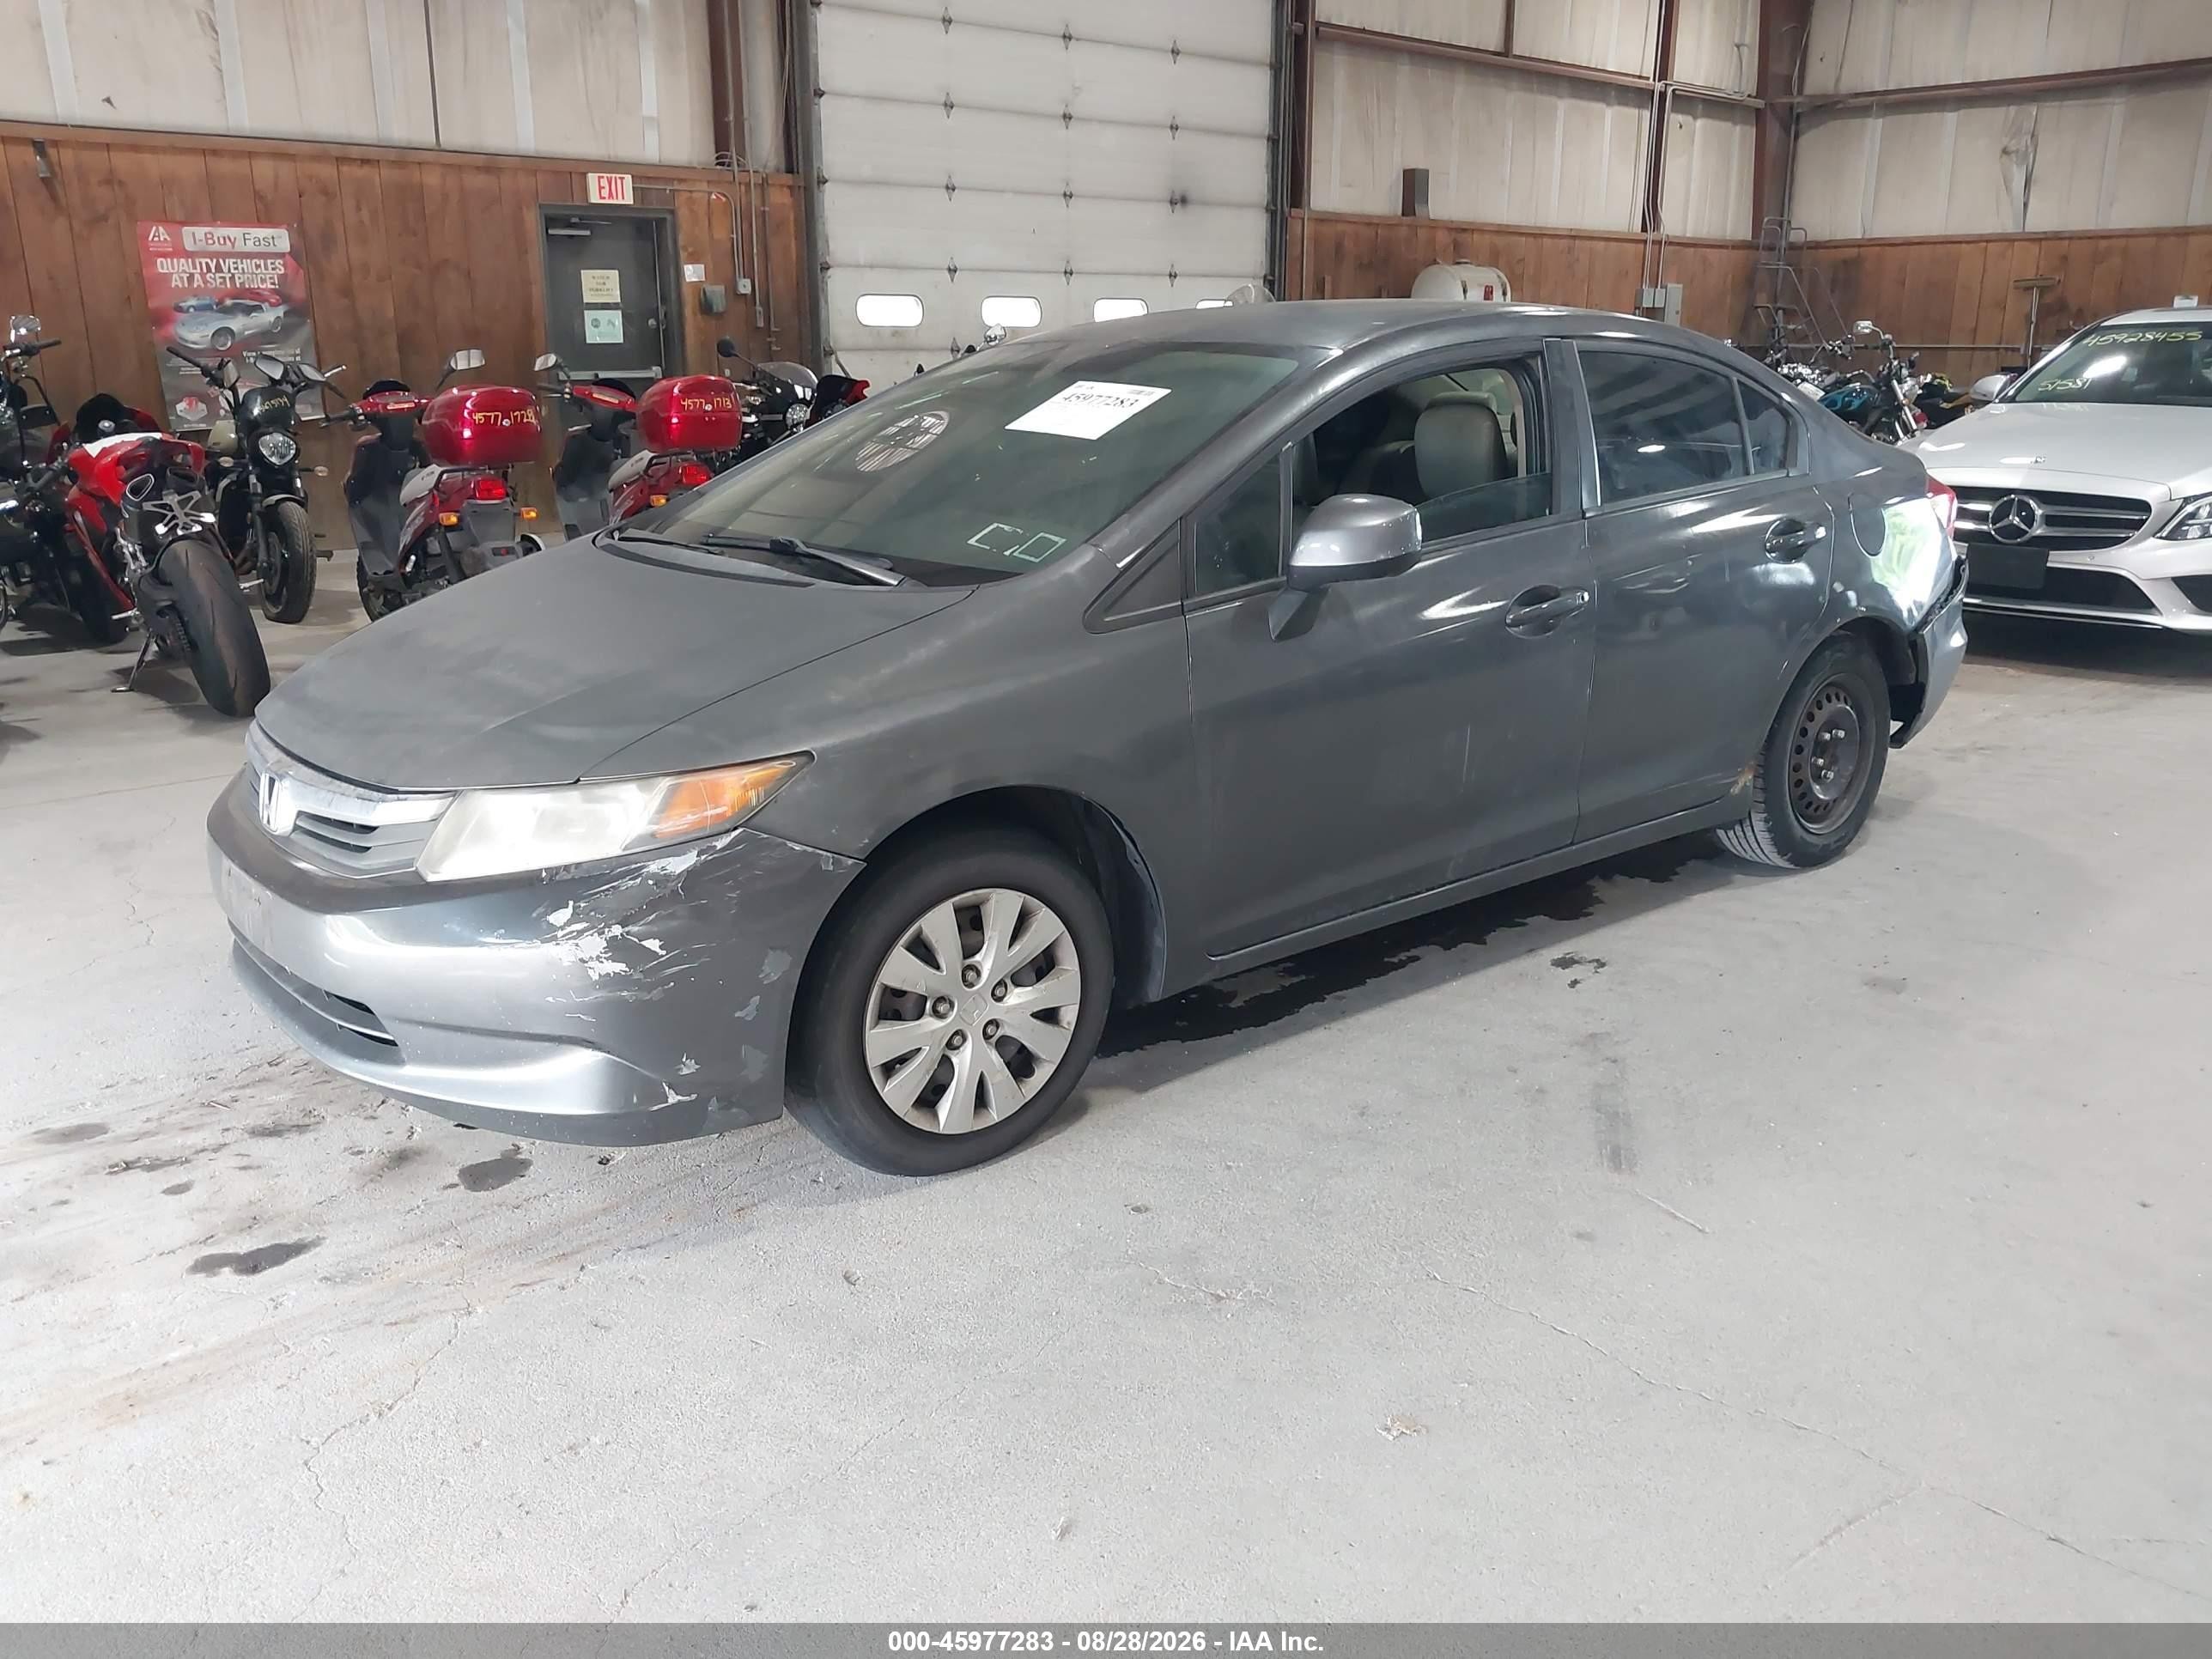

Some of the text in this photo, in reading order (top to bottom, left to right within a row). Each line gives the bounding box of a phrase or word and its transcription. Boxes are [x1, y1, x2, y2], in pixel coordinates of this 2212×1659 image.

[597, 175, 626, 200] EXIT
[191, 231, 237, 250] I-Buy
[242, 232, 277, 247] Fast
[156, 258, 285, 274] QUALITY VEHICLES
[171, 273, 279, 289] AT A SET PRICE!
[2082, 331, 2203, 347] 45928455
[681, 398, 705, 411] 4577
[471, 411, 501, 426] 4577
